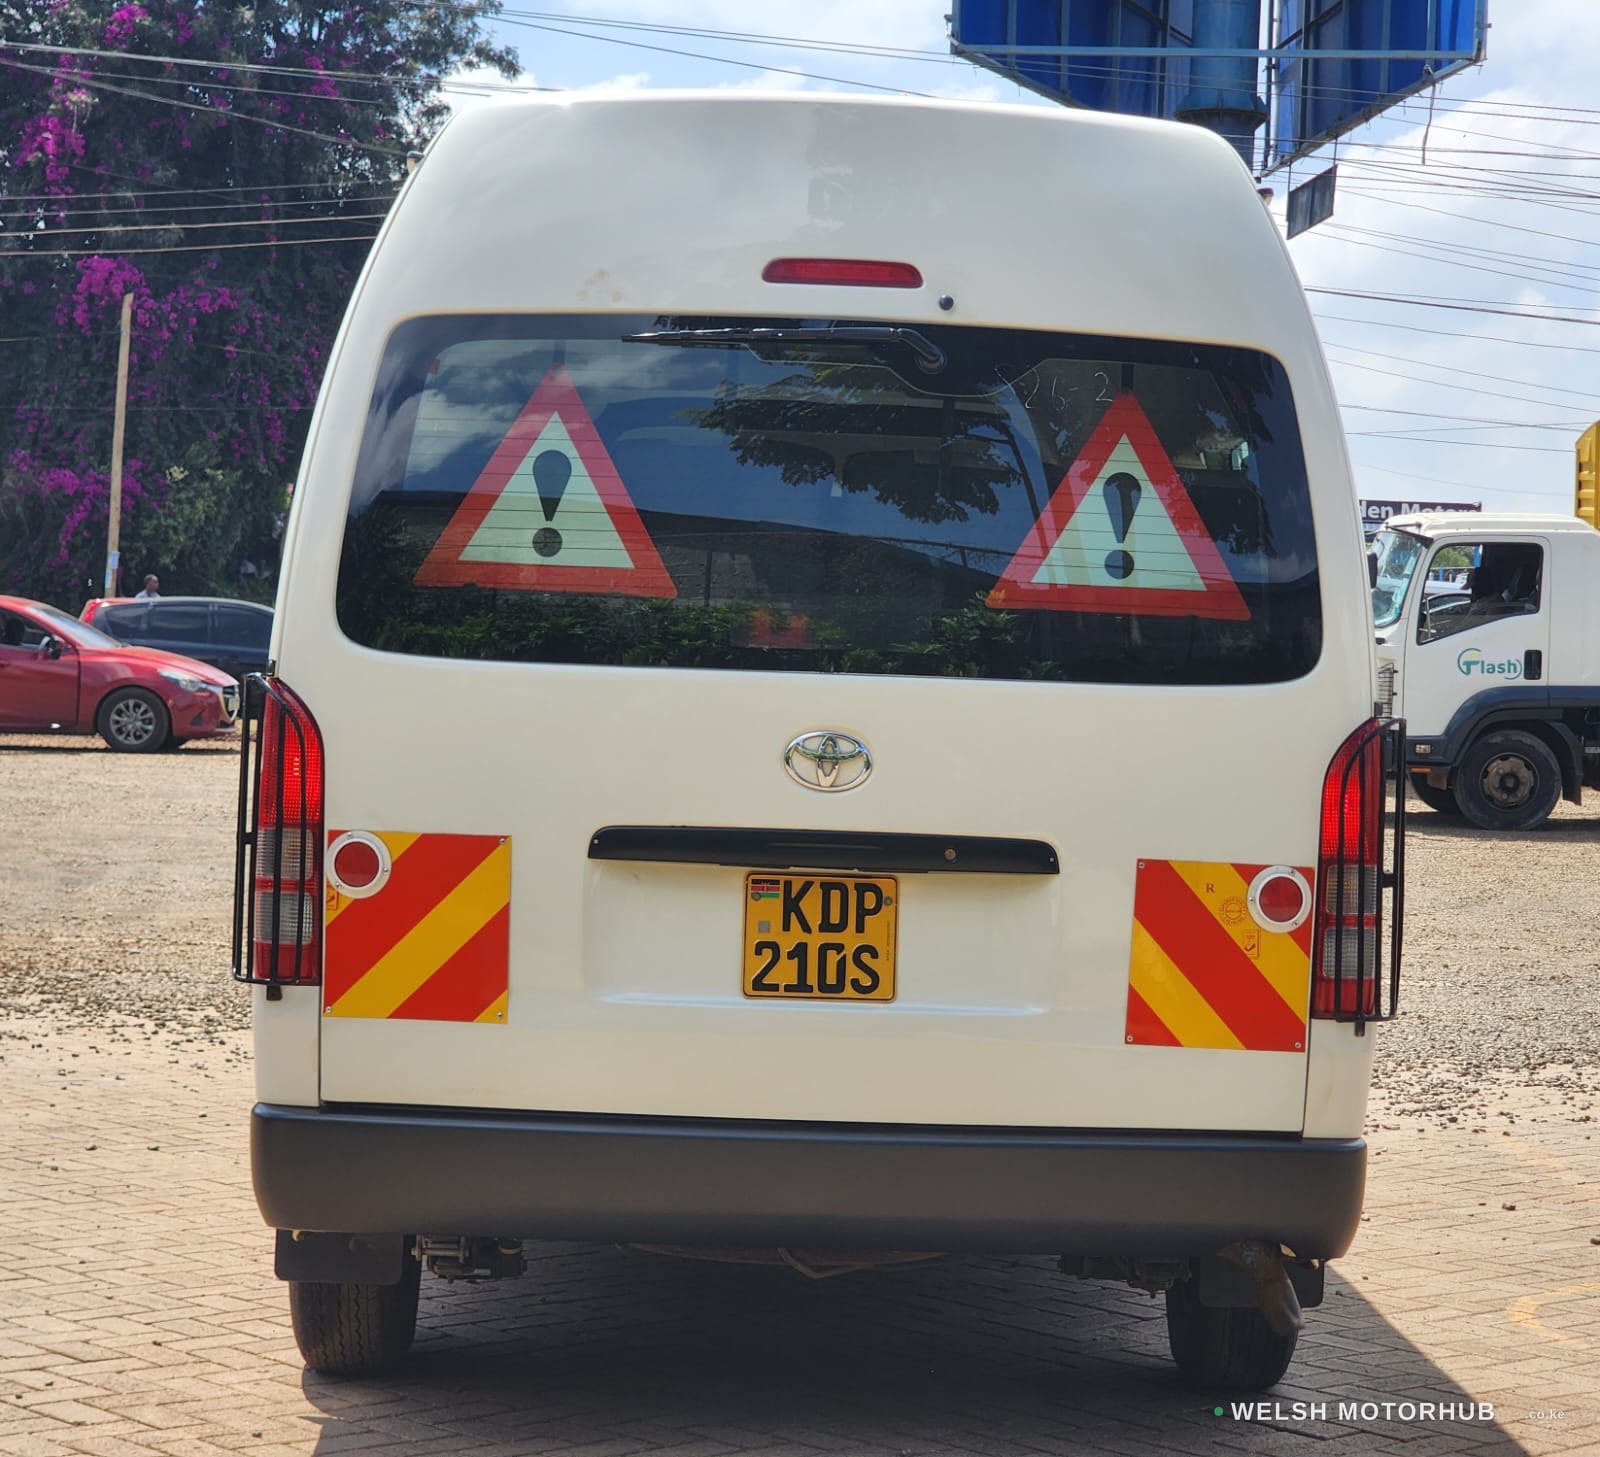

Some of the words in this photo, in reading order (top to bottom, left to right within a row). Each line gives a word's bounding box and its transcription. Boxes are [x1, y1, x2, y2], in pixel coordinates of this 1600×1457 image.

[782, 880, 884, 934] KDP
[1206, 883, 1215, 894] R
[751, 940, 880, 994] 210S
